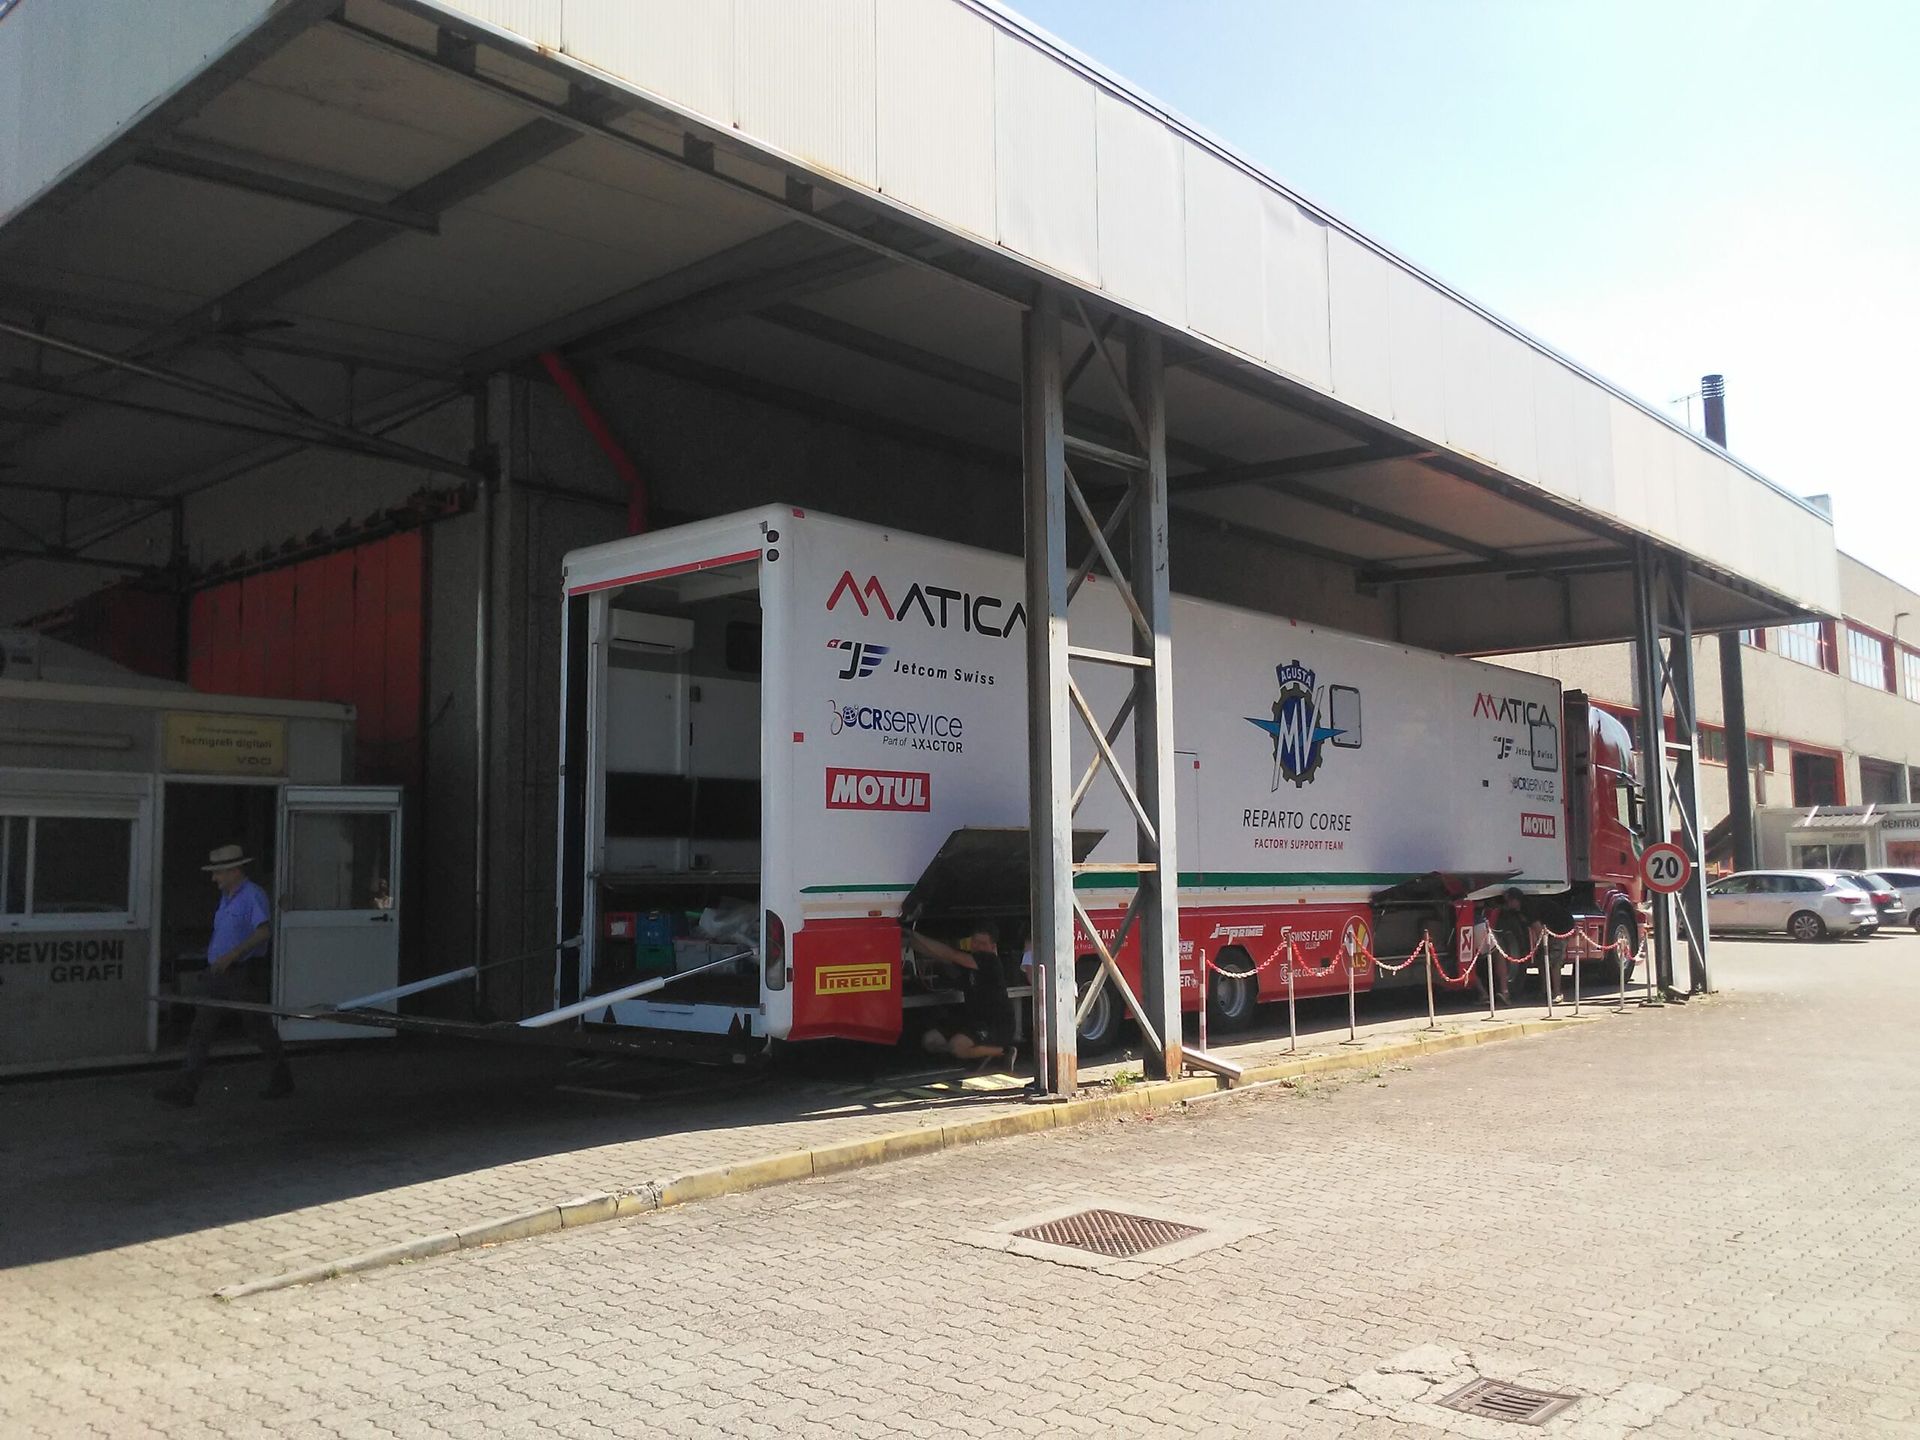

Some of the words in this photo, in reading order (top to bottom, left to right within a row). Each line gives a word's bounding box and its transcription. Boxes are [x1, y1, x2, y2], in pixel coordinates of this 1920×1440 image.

[826, 570, 1026, 638] MATICA
[893, 660, 948, 679] Jetcom
[954, 668, 995, 685] Swiss
[1281, 666, 1313, 687] AGUSTA
[1473, 692, 1552, 729] MATICA
[883, 735, 898, 746] Part
[900, 737, 907, 747] of
[911, 738, 963, 753] AXACTOR
[1271, 685, 1325, 793] MV
[831, 774, 926, 806] MOTUL
[1243, 809, 1304, 829] REPARTO
[1309, 812, 1353, 832] CORSE
[1523, 816, 1555, 836] MOTUL
[1881, 818, 1920, 829] CENTRO
[1254, 838, 1288, 849] FACTORY
[1290, 839, 1322, 850] SUPPORT
[1325, 840, 1344, 850] TEAM
[1651, 856, 1679, 879] 20
[1290, 931, 1311, 942] SWISS
[1311, 929, 1334, 941] FLIGHT
[50, 963, 124, 983] GRAFI
[819, 967, 888, 990] PIRELLI
